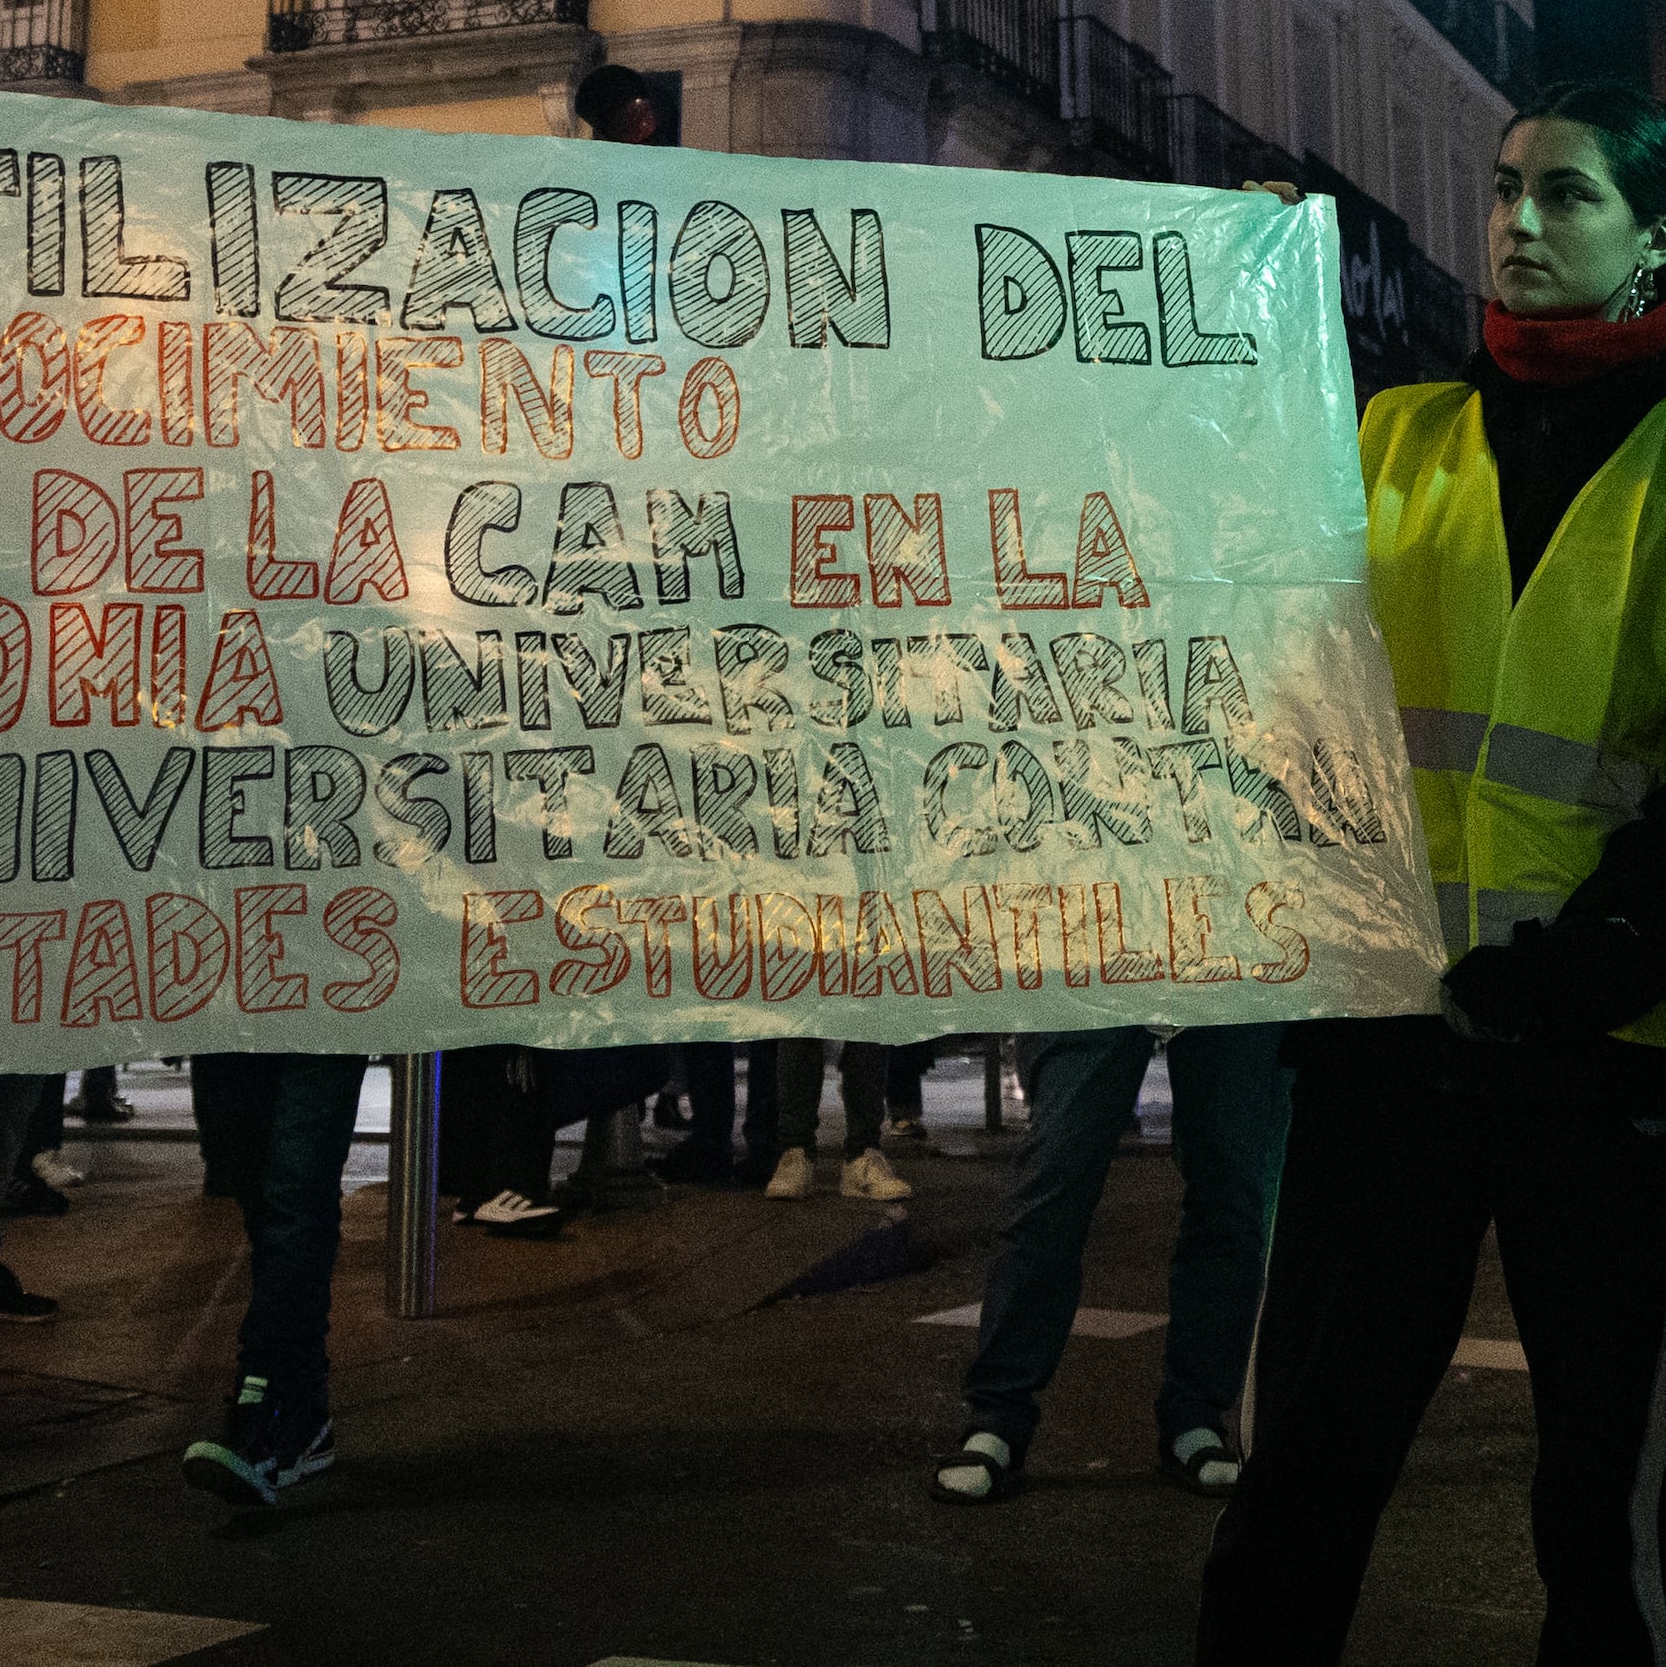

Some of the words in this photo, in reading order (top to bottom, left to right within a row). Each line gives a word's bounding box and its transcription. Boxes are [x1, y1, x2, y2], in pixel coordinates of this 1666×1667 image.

[974, 223, 1258, 368] DEL
[32, 466, 206, 598] DE
[246, 469, 410, 605] LA
[444, 480, 745, 616] CAM
[789, 492, 953, 609] EN
[987, 486, 1151, 610] LA
[323, 622, 1255, 739] UNIVERSITARIA
[922, 735, 1387, 858] CONTRA
[459, 876, 1311, 1011] ESTUDIANTILES
